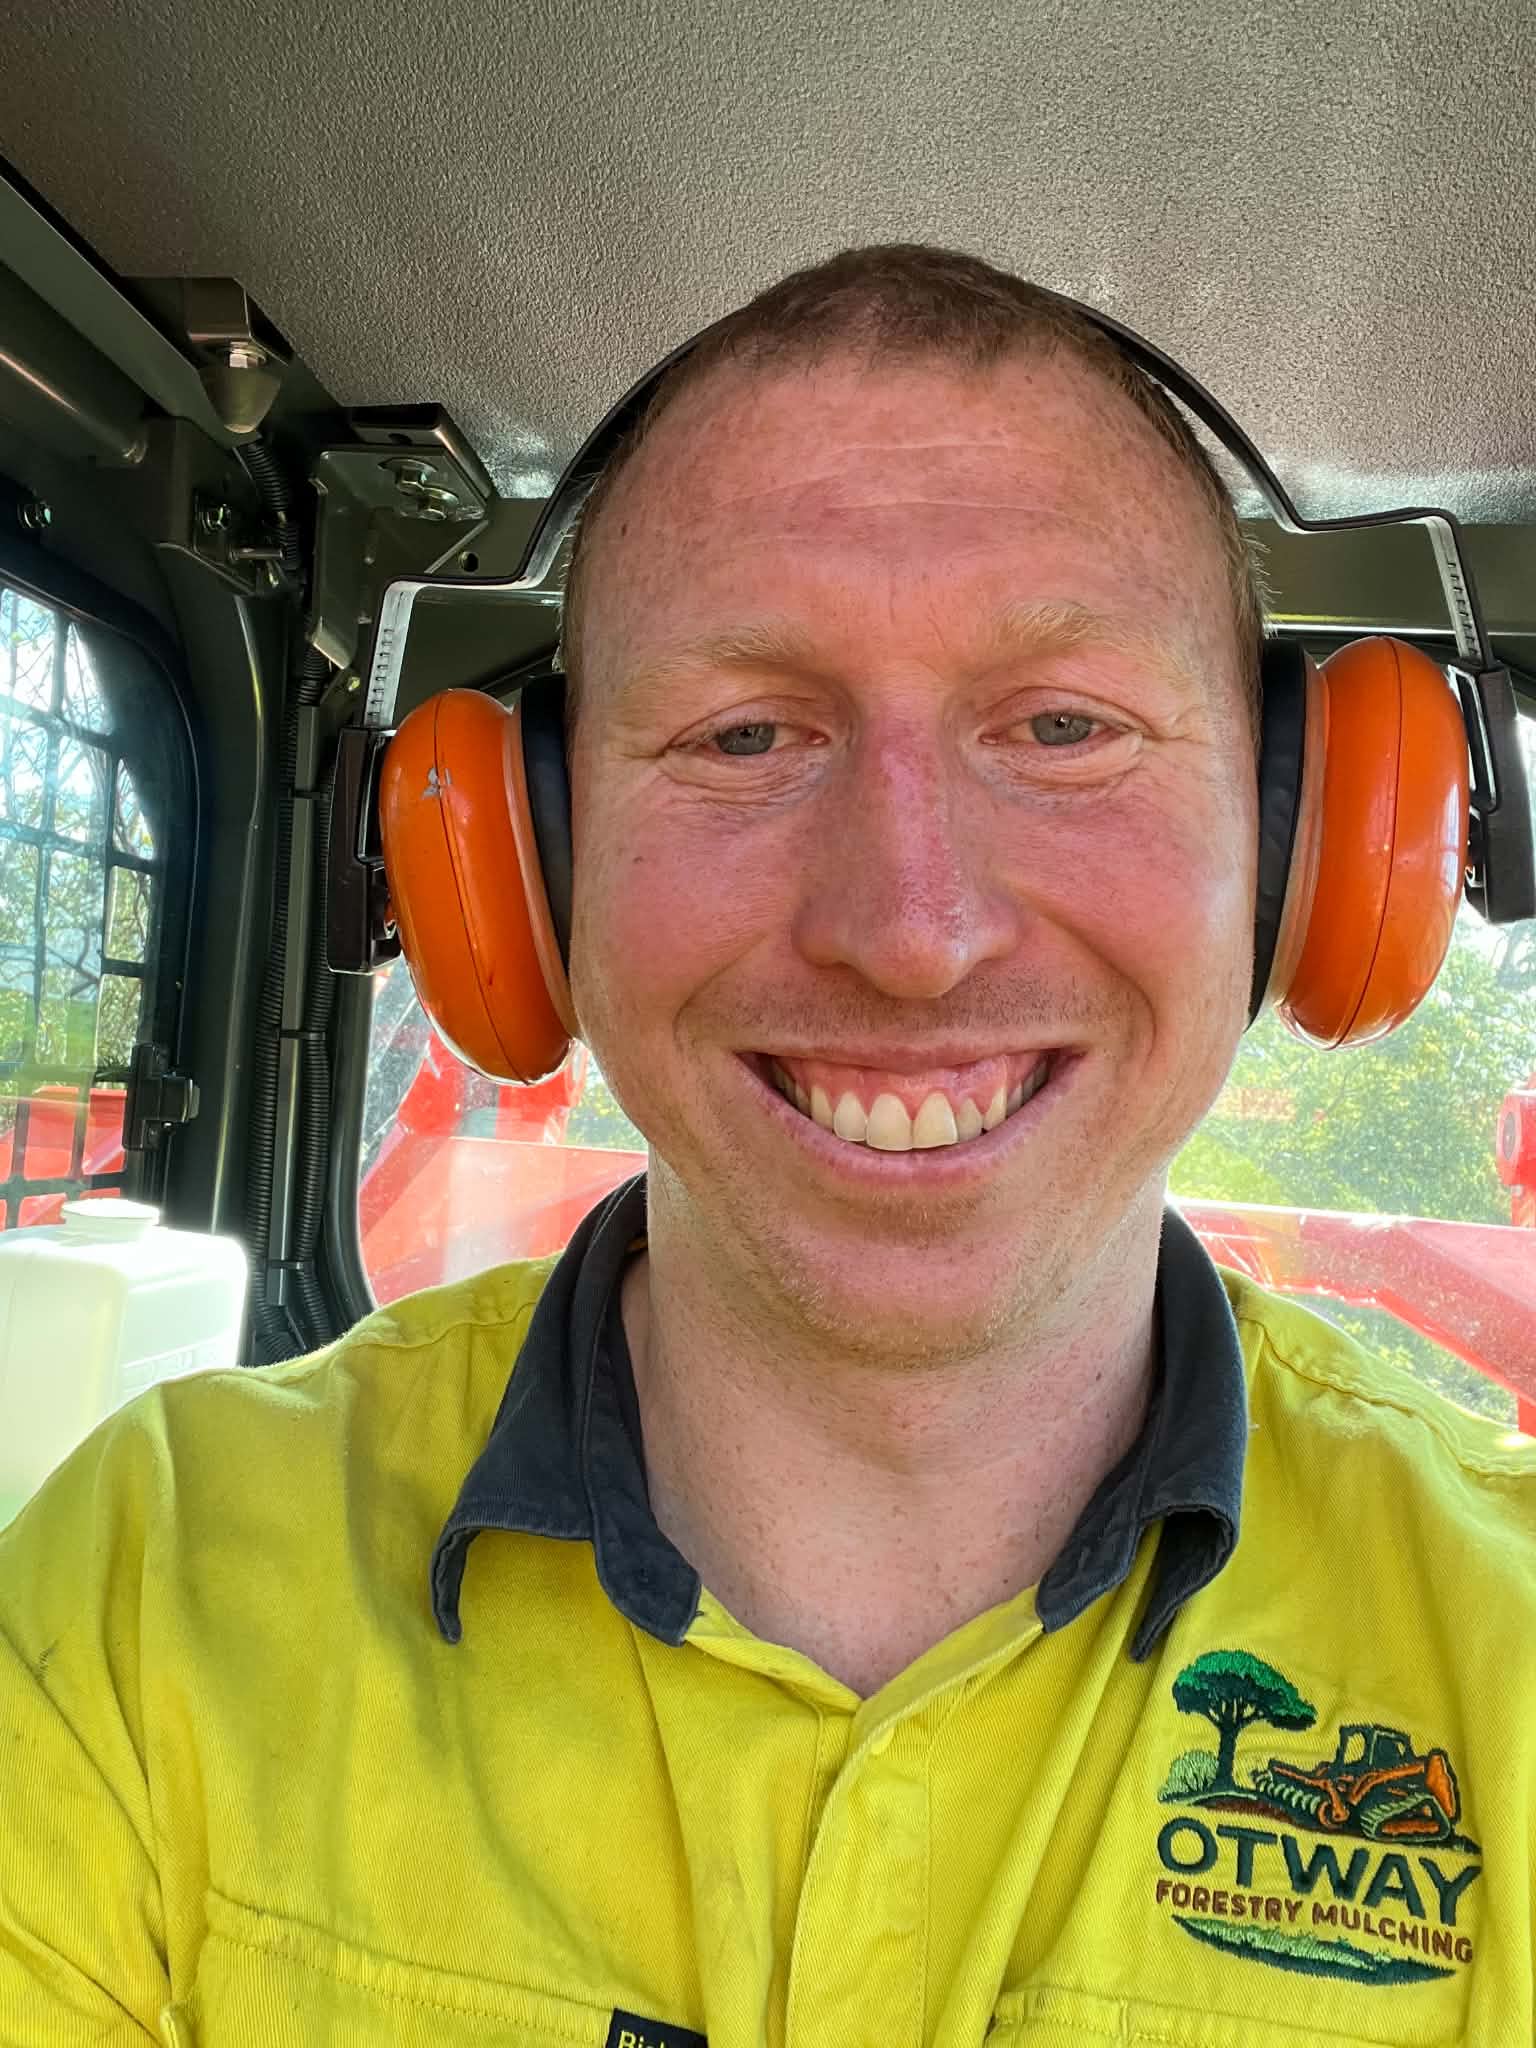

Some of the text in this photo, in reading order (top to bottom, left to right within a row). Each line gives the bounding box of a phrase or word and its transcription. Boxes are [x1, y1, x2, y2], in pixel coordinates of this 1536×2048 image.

[1157, 1816, 1483, 1926] OTWAY
[1156, 1879, 1473, 1964] FORESTRY MULCHING
